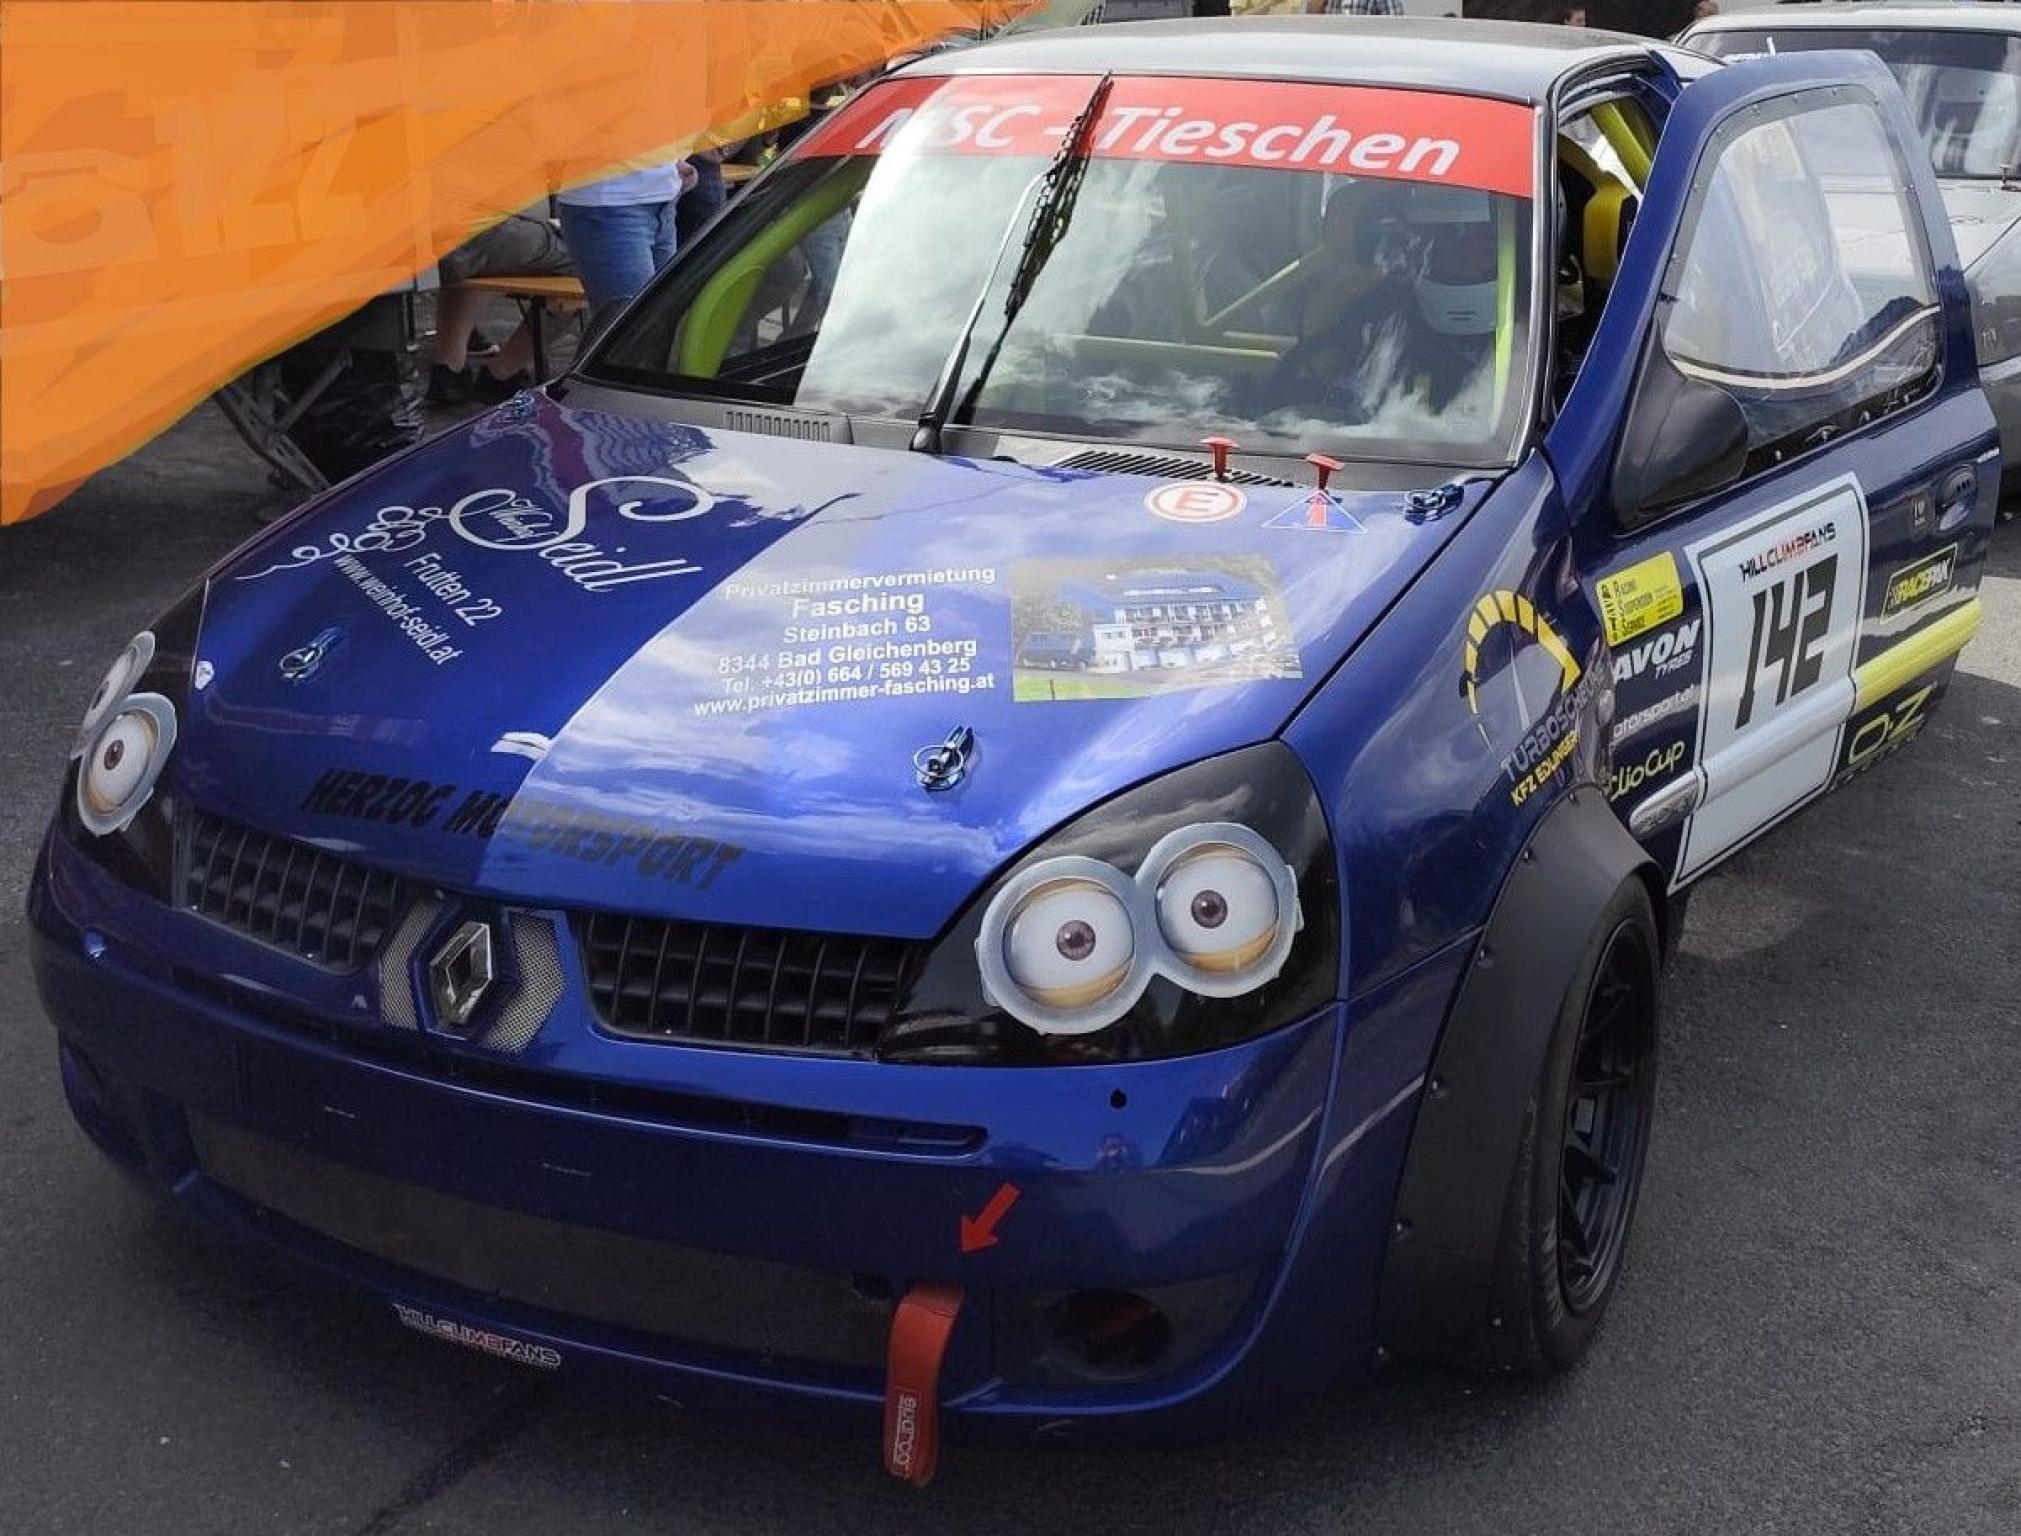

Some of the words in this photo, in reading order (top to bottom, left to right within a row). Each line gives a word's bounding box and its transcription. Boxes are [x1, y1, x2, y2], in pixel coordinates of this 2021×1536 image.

[1098, 104, 1460, 176] Tieschen
[449, 475, 715, 592] Seidl
[404, 553, 472, 605] Frutten
[455, 598, 503, 626] 22
[724, 567, 997, 600] Privatzimmervermietung
[792, 592, 925, 618] Fasching
[334, 554, 464, 665] www.weinhof-seidl.at
[783, 617, 897, 644] Steinbach
[904, 615, 932, 634] 63
[717, 655, 771, 675] 8344
[777, 647, 822, 669] Bad
[828, 638, 978, 664] Gleichenberg
[1613, 618, 1701, 685] AVON
[1735, 553, 1838, 730] 142
[693, 673, 996, 716] www.privatzimmer-fasching.at
[762, 669, 822, 689] +43(0)
[827, 666, 862, 682] 664
[879, 662, 913, 679] 569
[919, 659, 942, 676] 43
[948, 657, 972, 673] 25
[1510, 774, 1537, 807] KFZ
